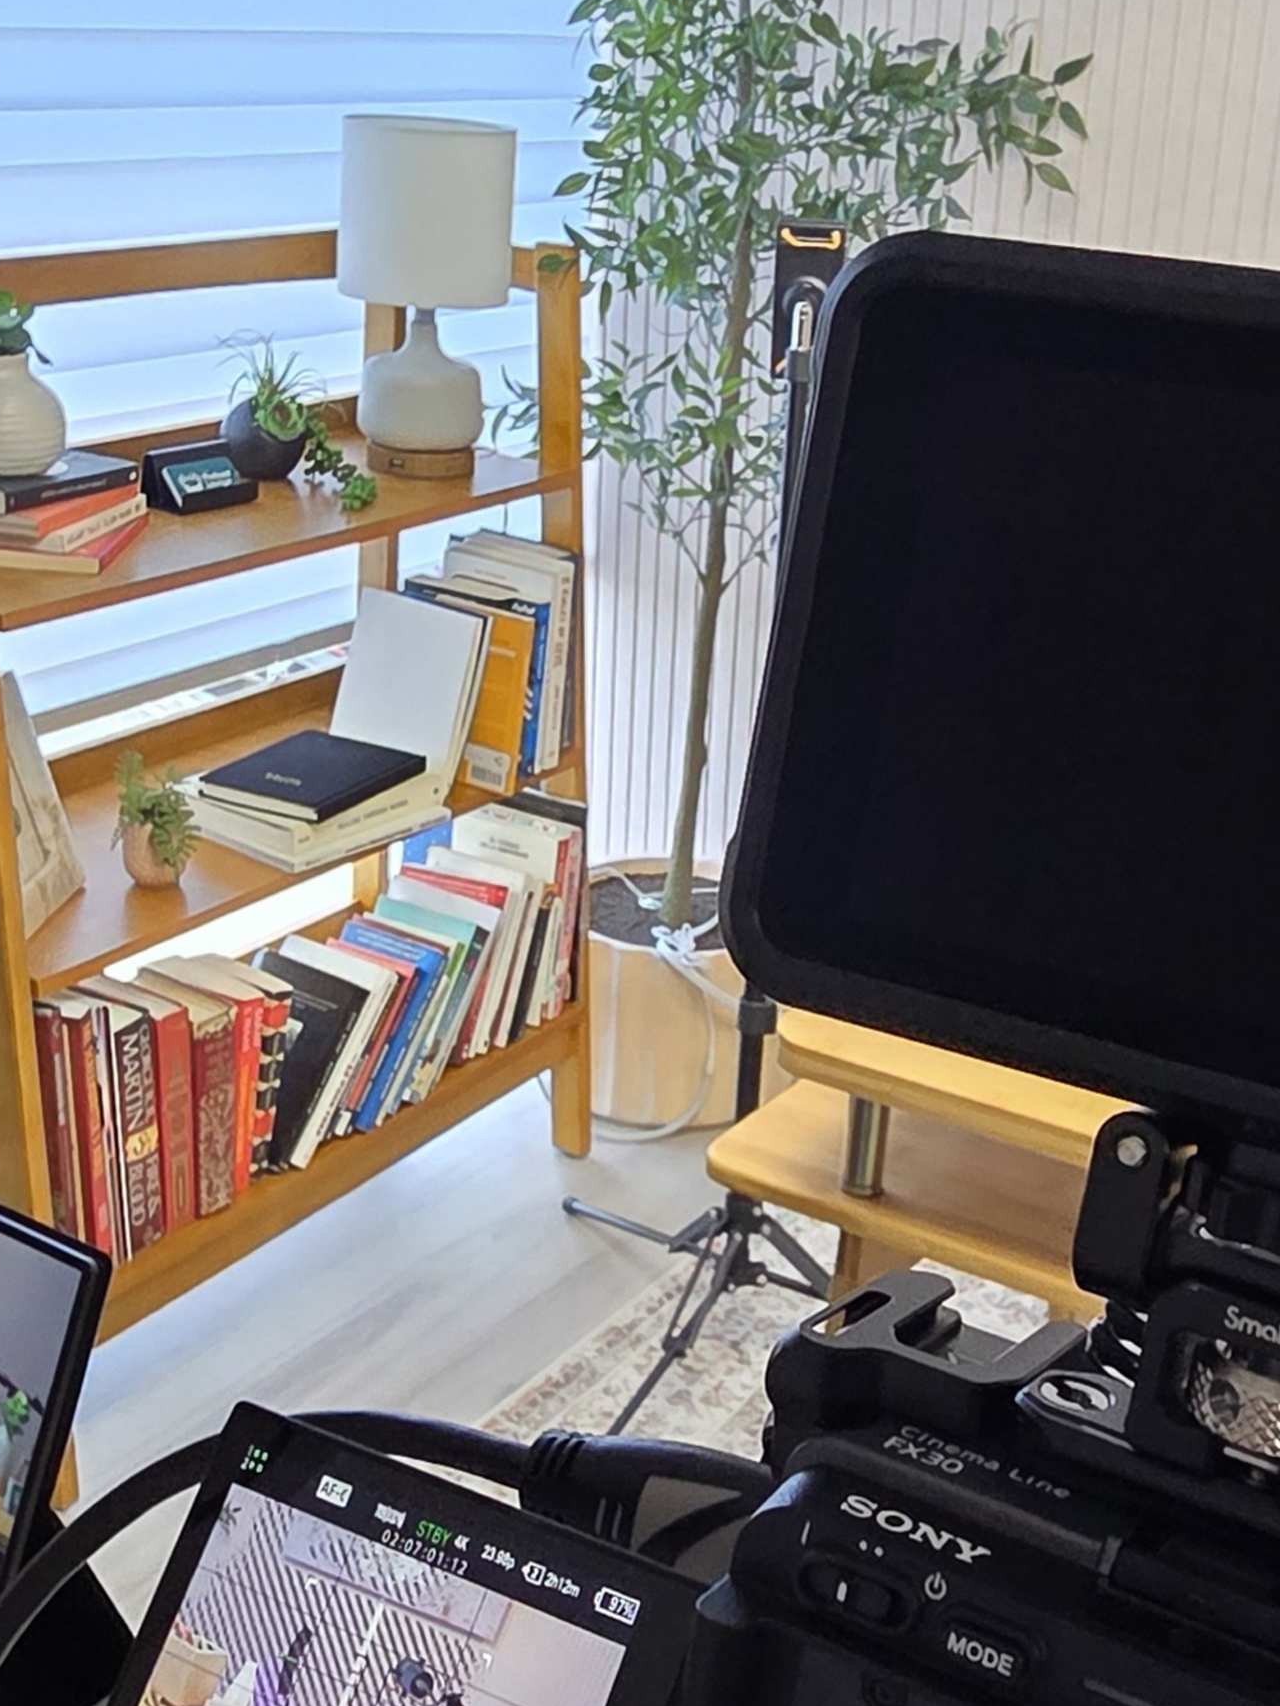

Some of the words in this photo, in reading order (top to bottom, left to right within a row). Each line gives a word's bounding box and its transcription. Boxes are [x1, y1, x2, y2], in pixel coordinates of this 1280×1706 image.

[120, 1032, 147, 1131] MARTIN
[882, 1435, 965, 1475] FX30
[900, 1424, 1001, 1472] Cinema
[1008, 1467, 1071, 1499] Line
[381, 1529, 469, 1576] 02:07:01:12
[415, 1519, 452, 1548] STBY
[839, 1493, 991, 1565] SONY
[947, 1631, 1015, 1677] MODE
